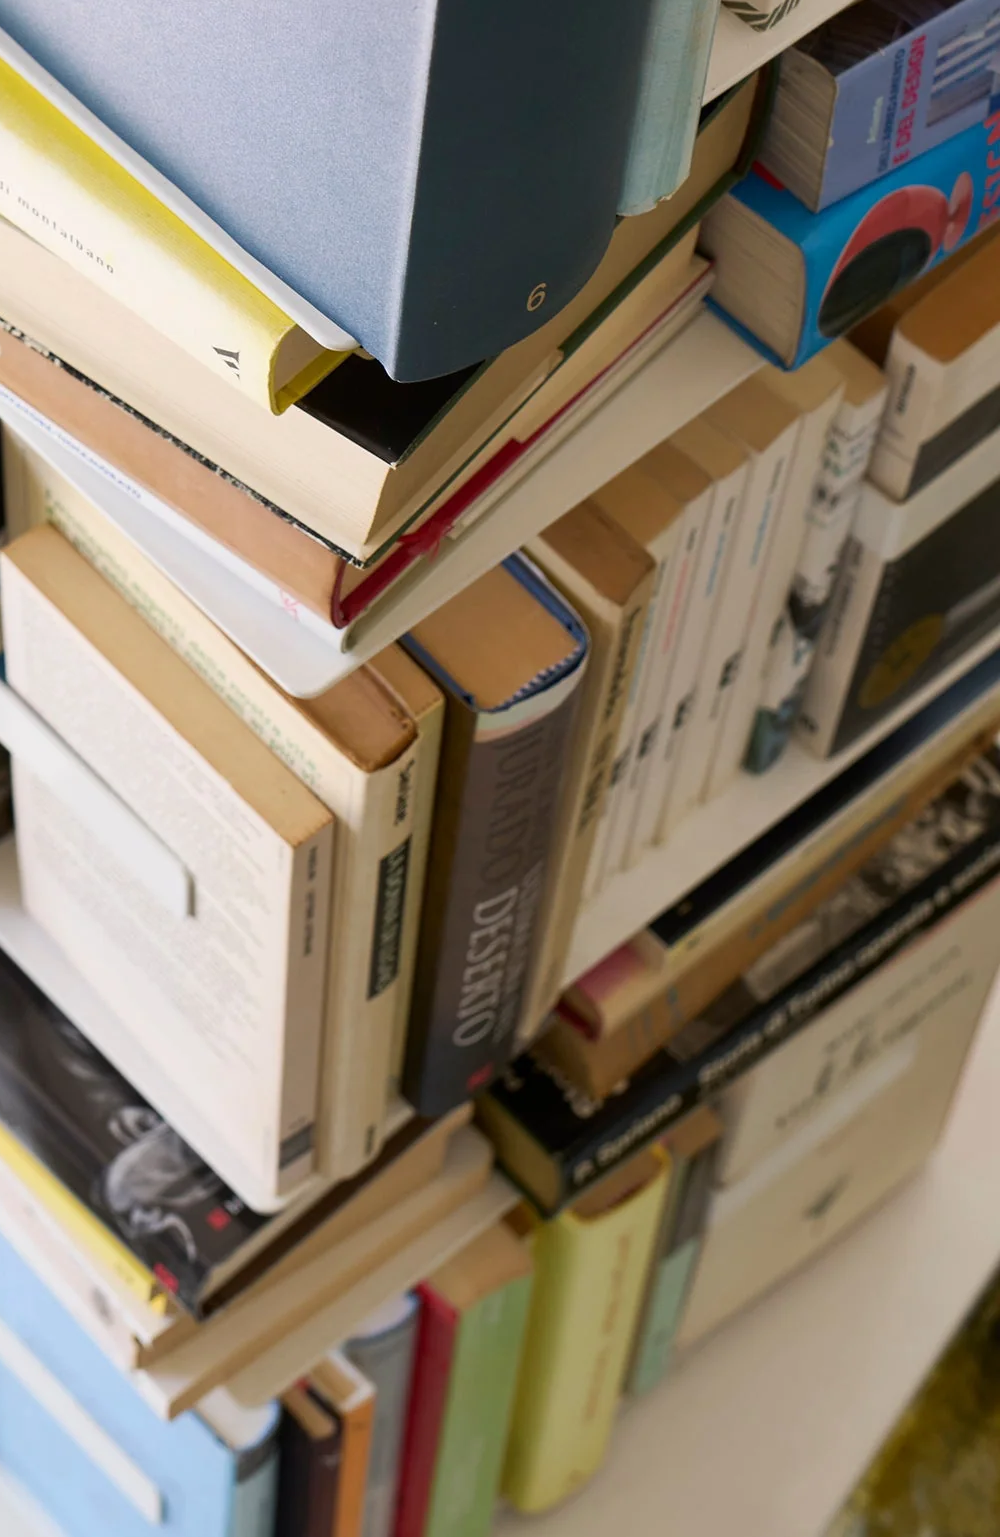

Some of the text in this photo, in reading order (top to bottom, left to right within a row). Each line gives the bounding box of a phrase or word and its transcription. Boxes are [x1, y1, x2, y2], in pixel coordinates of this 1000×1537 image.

[17, 195, 115, 275] montalbano
[526, 282, 547, 313] 6
[484, 729, 542, 890] JURADO
[451, 884, 519, 1050] DESERTO
